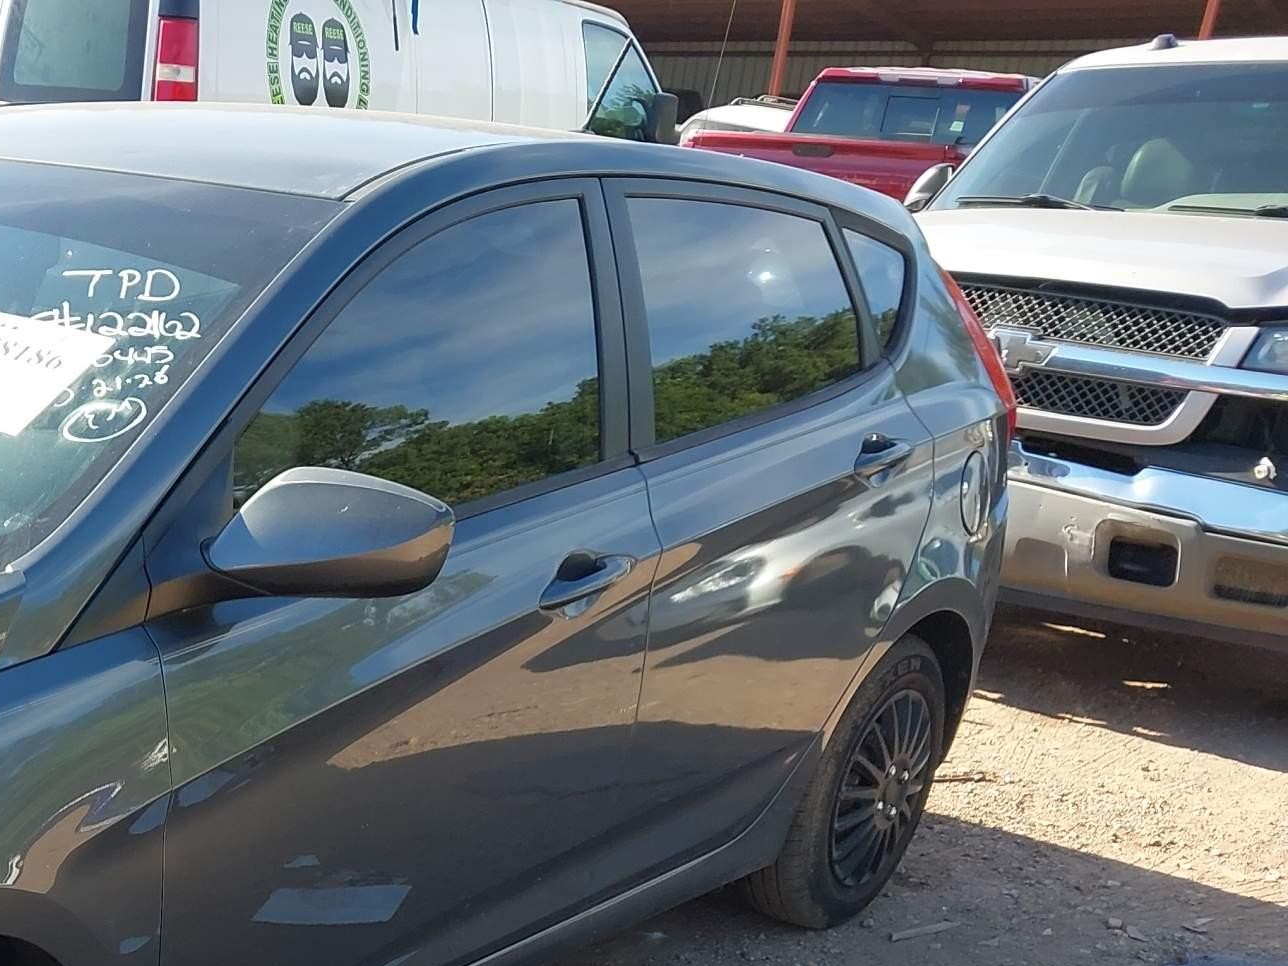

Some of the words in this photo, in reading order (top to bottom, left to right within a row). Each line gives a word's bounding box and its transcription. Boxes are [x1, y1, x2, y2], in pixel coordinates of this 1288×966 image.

[268, 0, 289, 58] HEATIN
[293, 22, 313, 35] REESE
[325, 27, 344, 40] REESE
[63, 269, 180, 301] TPD
